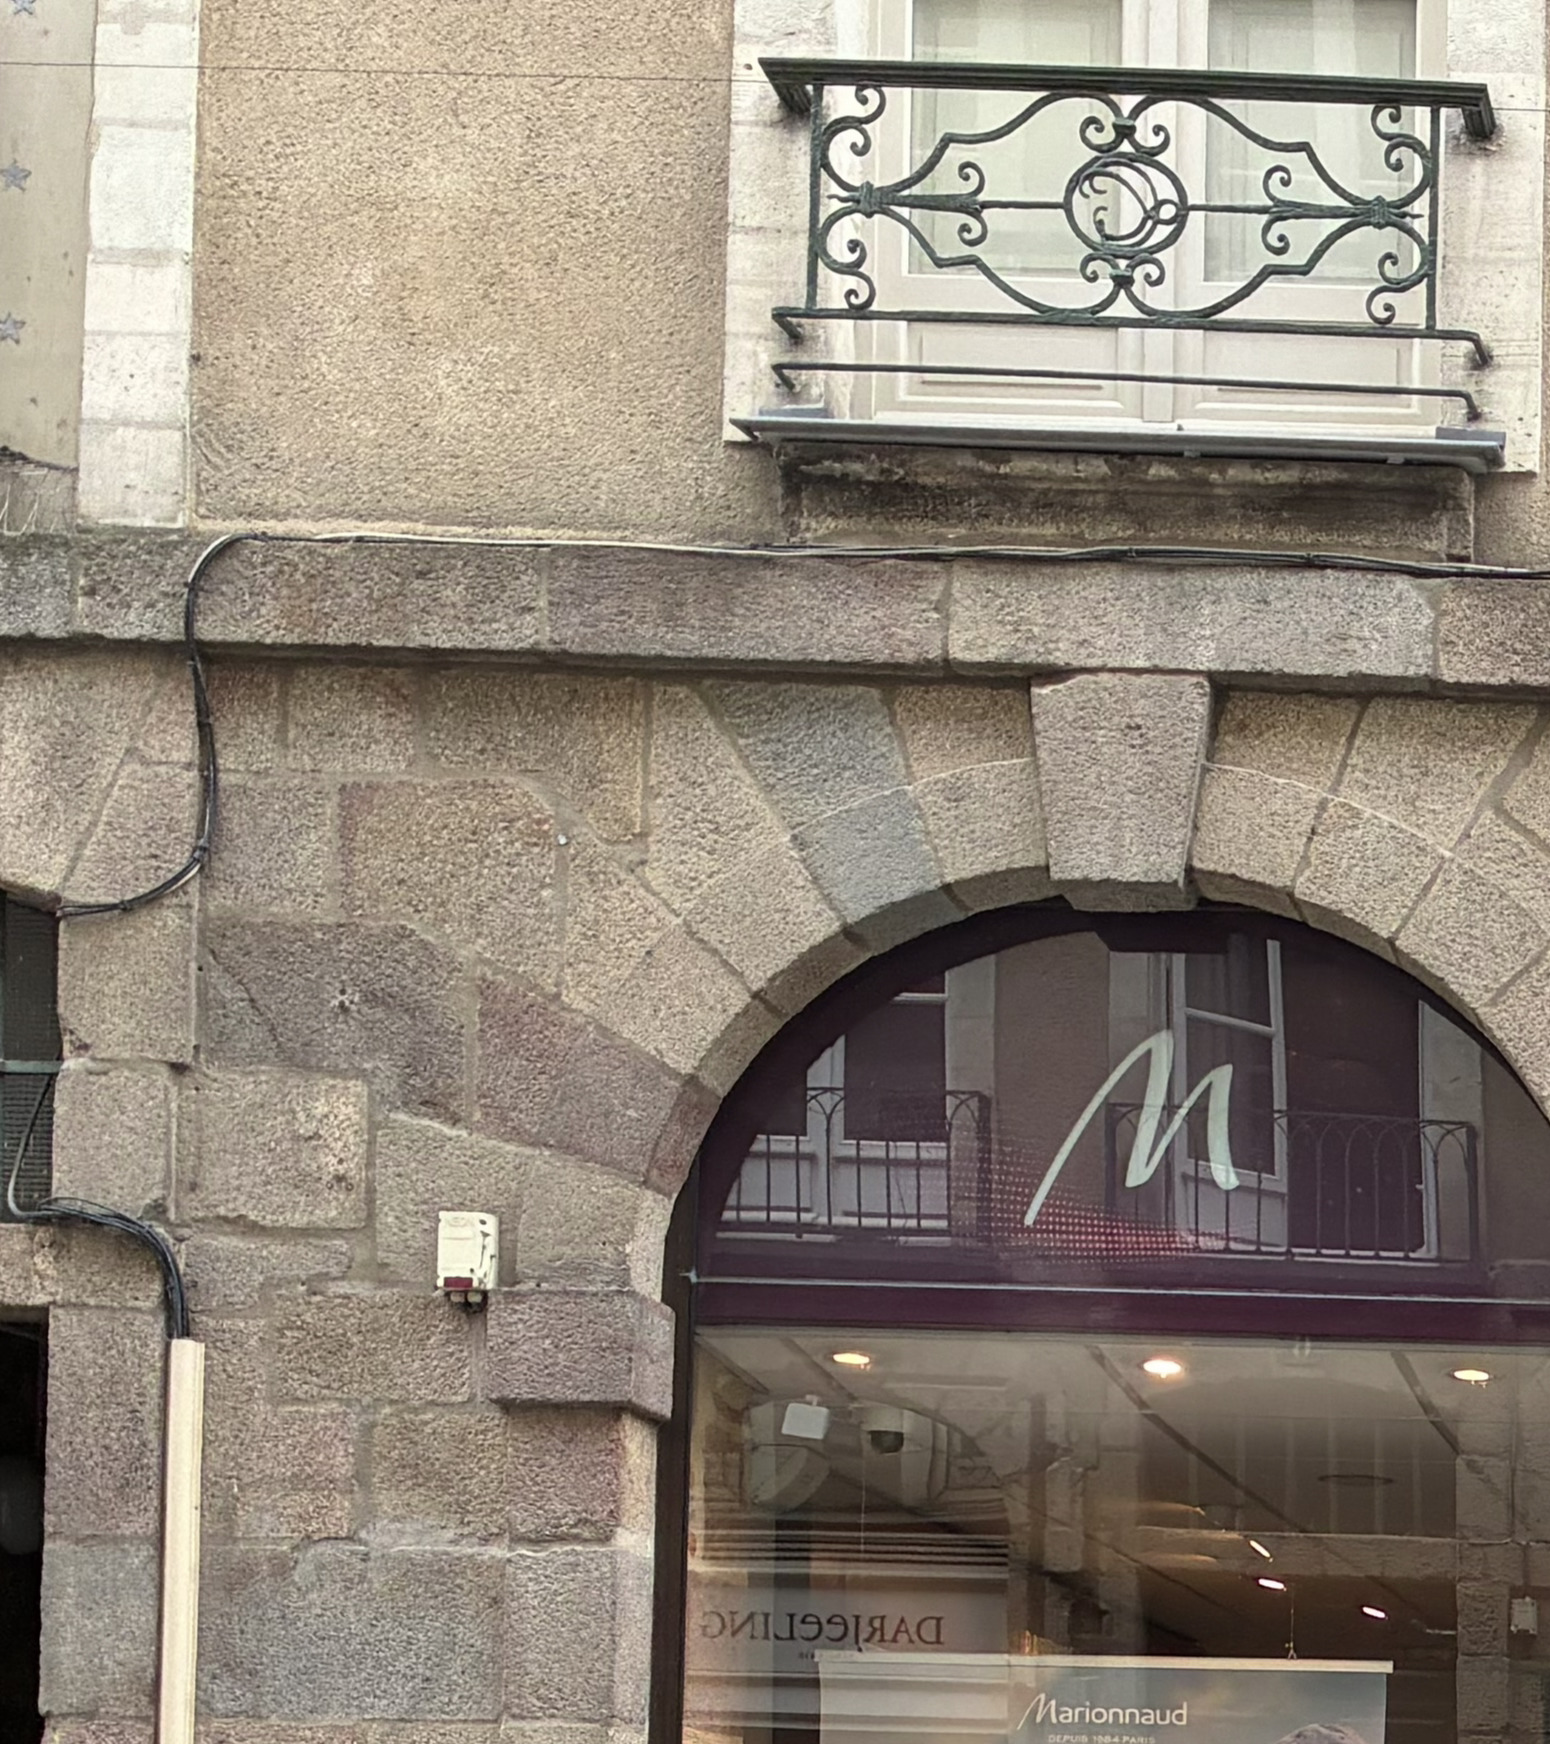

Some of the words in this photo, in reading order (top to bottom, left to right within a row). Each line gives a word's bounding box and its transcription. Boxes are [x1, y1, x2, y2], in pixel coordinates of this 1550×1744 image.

[1016, 1692, 1188, 1730] Marionnaud
[1048, 1734, 1088, 1744] DEPUIS
[1122, 1735, 1156, 1744] PARIS
